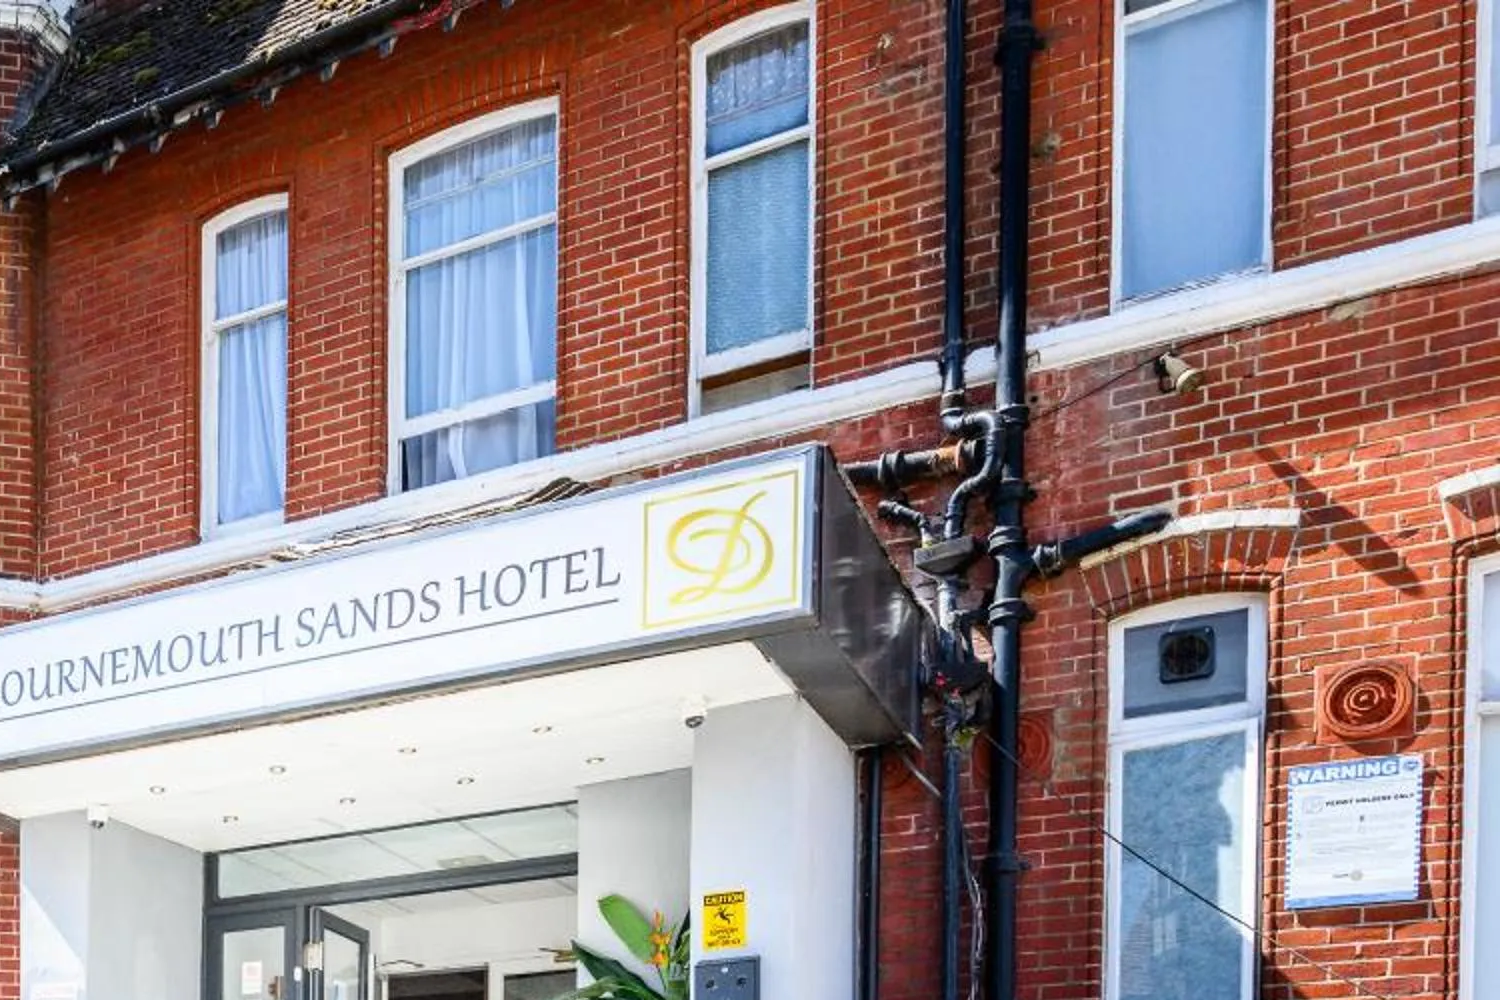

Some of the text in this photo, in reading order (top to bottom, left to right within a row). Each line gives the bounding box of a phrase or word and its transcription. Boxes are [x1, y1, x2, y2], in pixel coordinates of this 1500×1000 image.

[295, 580, 442, 648] SANDS
[455, 545, 622, 616] HOTEL
[1289, 760, 1397, 785] WARNING
